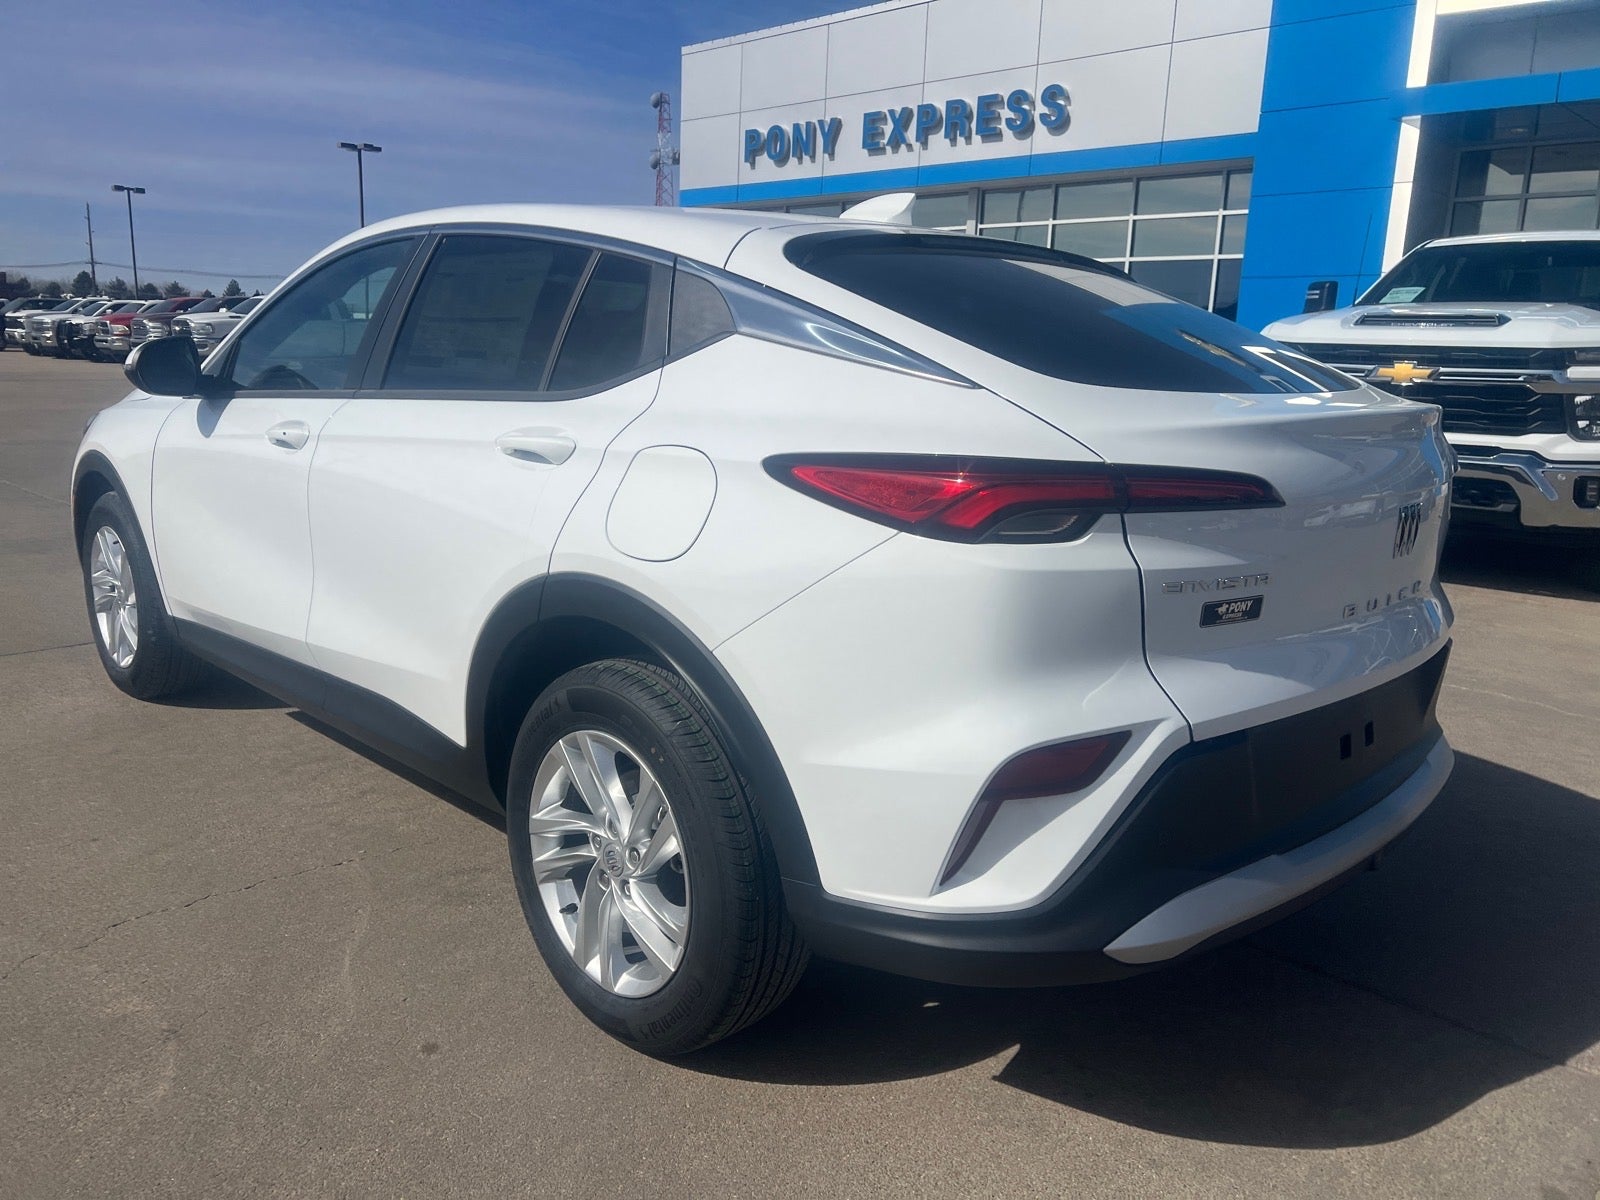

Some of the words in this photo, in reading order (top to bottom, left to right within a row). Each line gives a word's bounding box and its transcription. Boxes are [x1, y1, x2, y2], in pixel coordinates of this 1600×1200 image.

[744, 116, 842, 168] PONY
[861, 83, 1071, 156] EXPRESS
[1228, 599, 1254, 614] PONY
